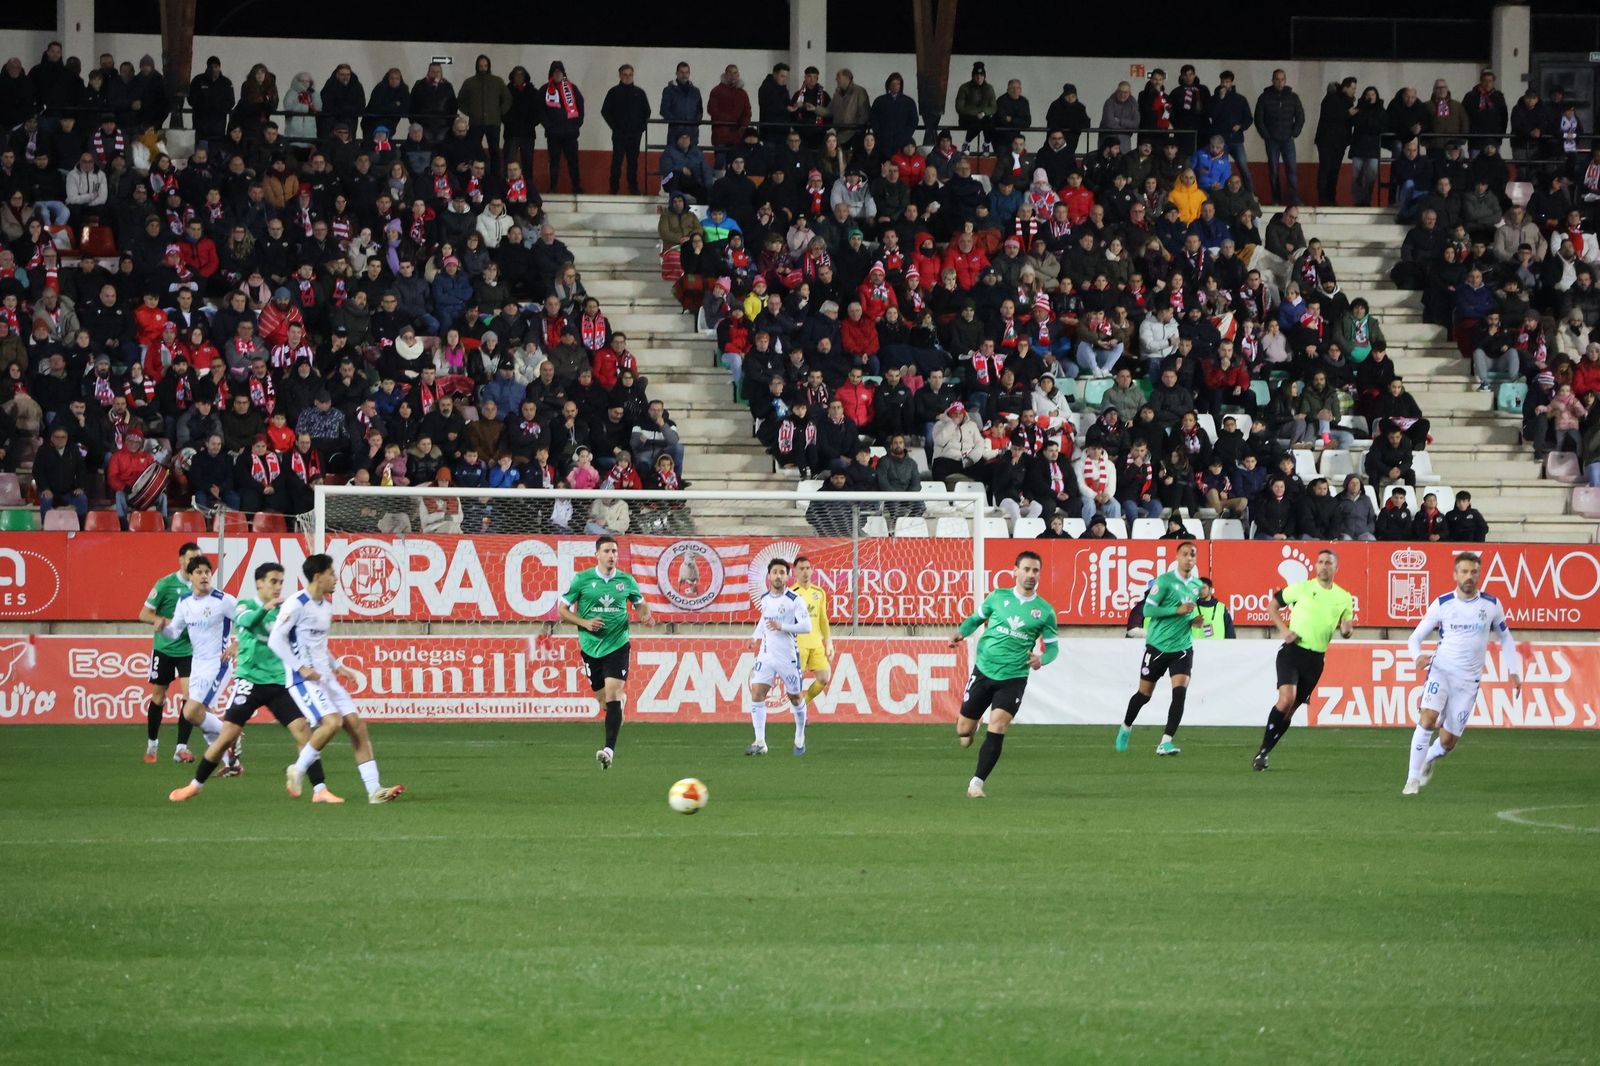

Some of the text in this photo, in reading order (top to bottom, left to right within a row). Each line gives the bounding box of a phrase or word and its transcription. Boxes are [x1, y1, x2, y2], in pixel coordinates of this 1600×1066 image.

[672, 544, 707, 554] FONDO
[815, 560, 1038, 594] NTRO ÓPTIC
[1452, 551, 1600, 600] AMO
[666, 591, 715, 606] MODORRO
[1504, 608, 1581, 623] AMIENTO
[374, 644, 566, 666] bodegas del
[1372, 649, 1572, 682] PEANAS
[335, 652, 584, 695] Sumiller
[637, 652, 957, 715] ZAMA CF
[1427, 681, 1440, 695] 16
